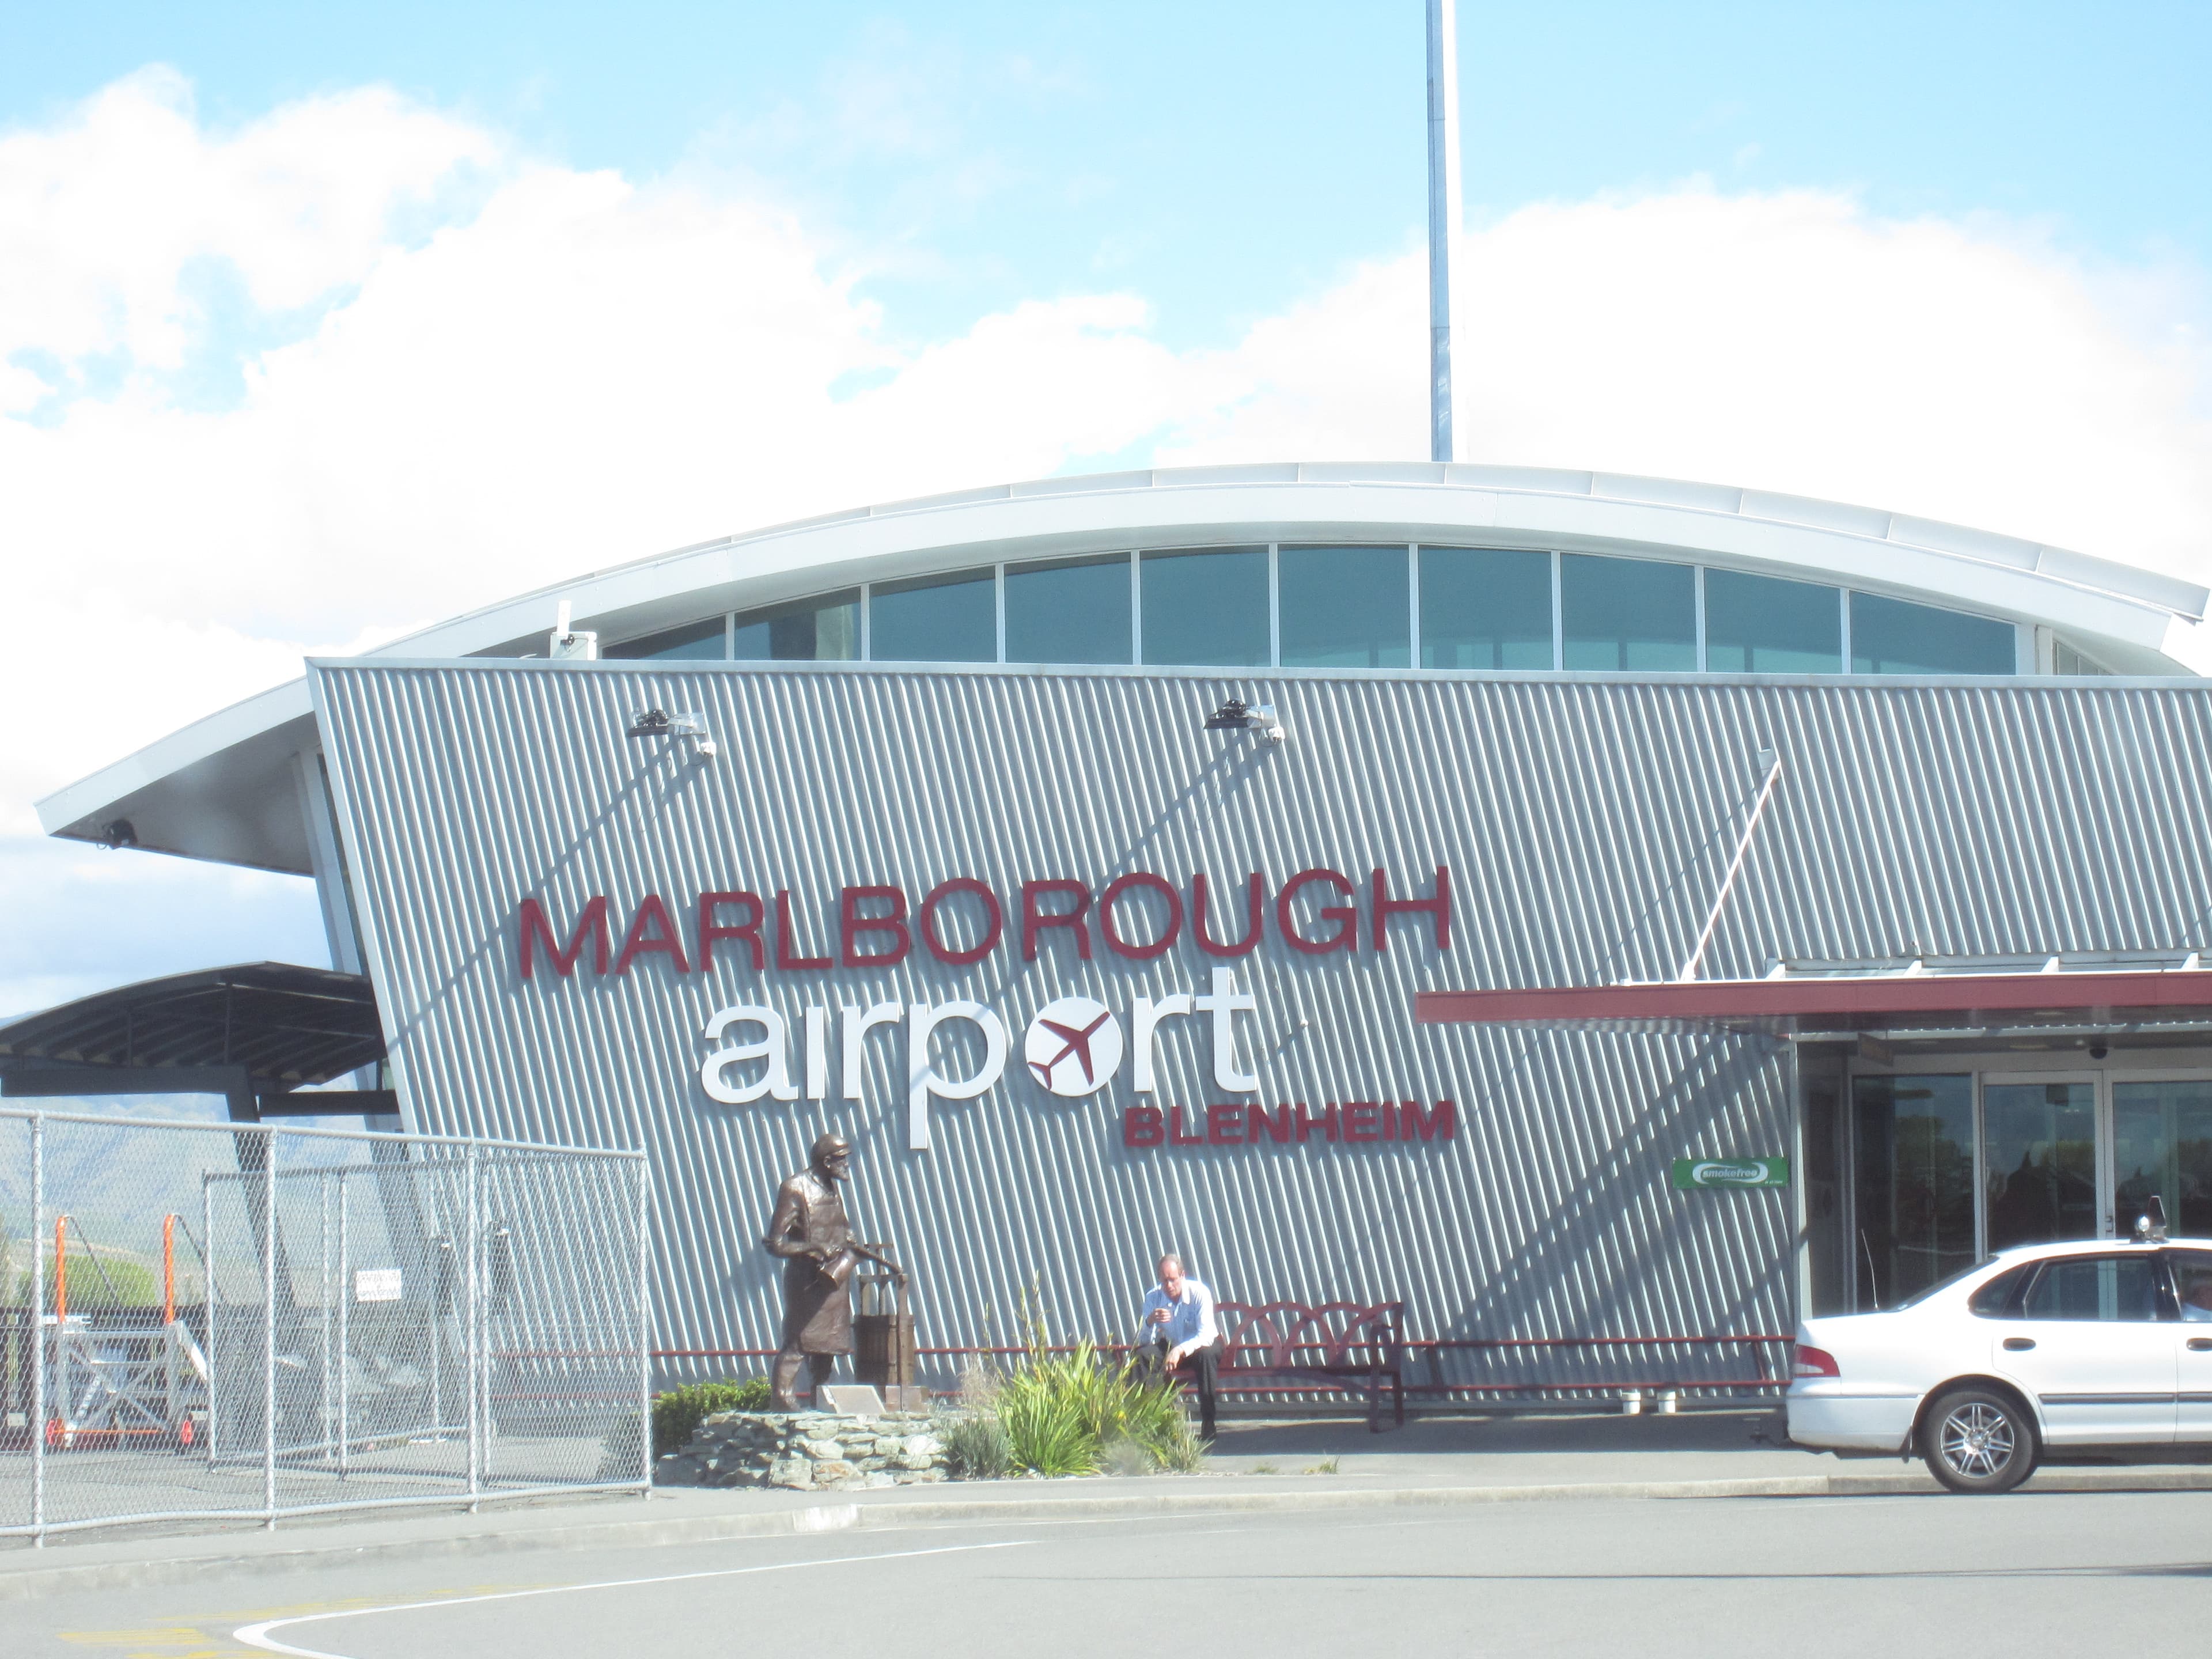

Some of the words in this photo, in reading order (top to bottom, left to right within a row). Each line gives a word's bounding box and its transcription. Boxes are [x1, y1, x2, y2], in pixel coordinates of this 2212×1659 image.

[519, 865, 1450, 978] MARLBOROUGH
[701, 965, 1257, 1149] airport
[1124, 1100, 1455, 1147] BLENHEIM
[1702, 1168, 1757, 1179] smokefree
